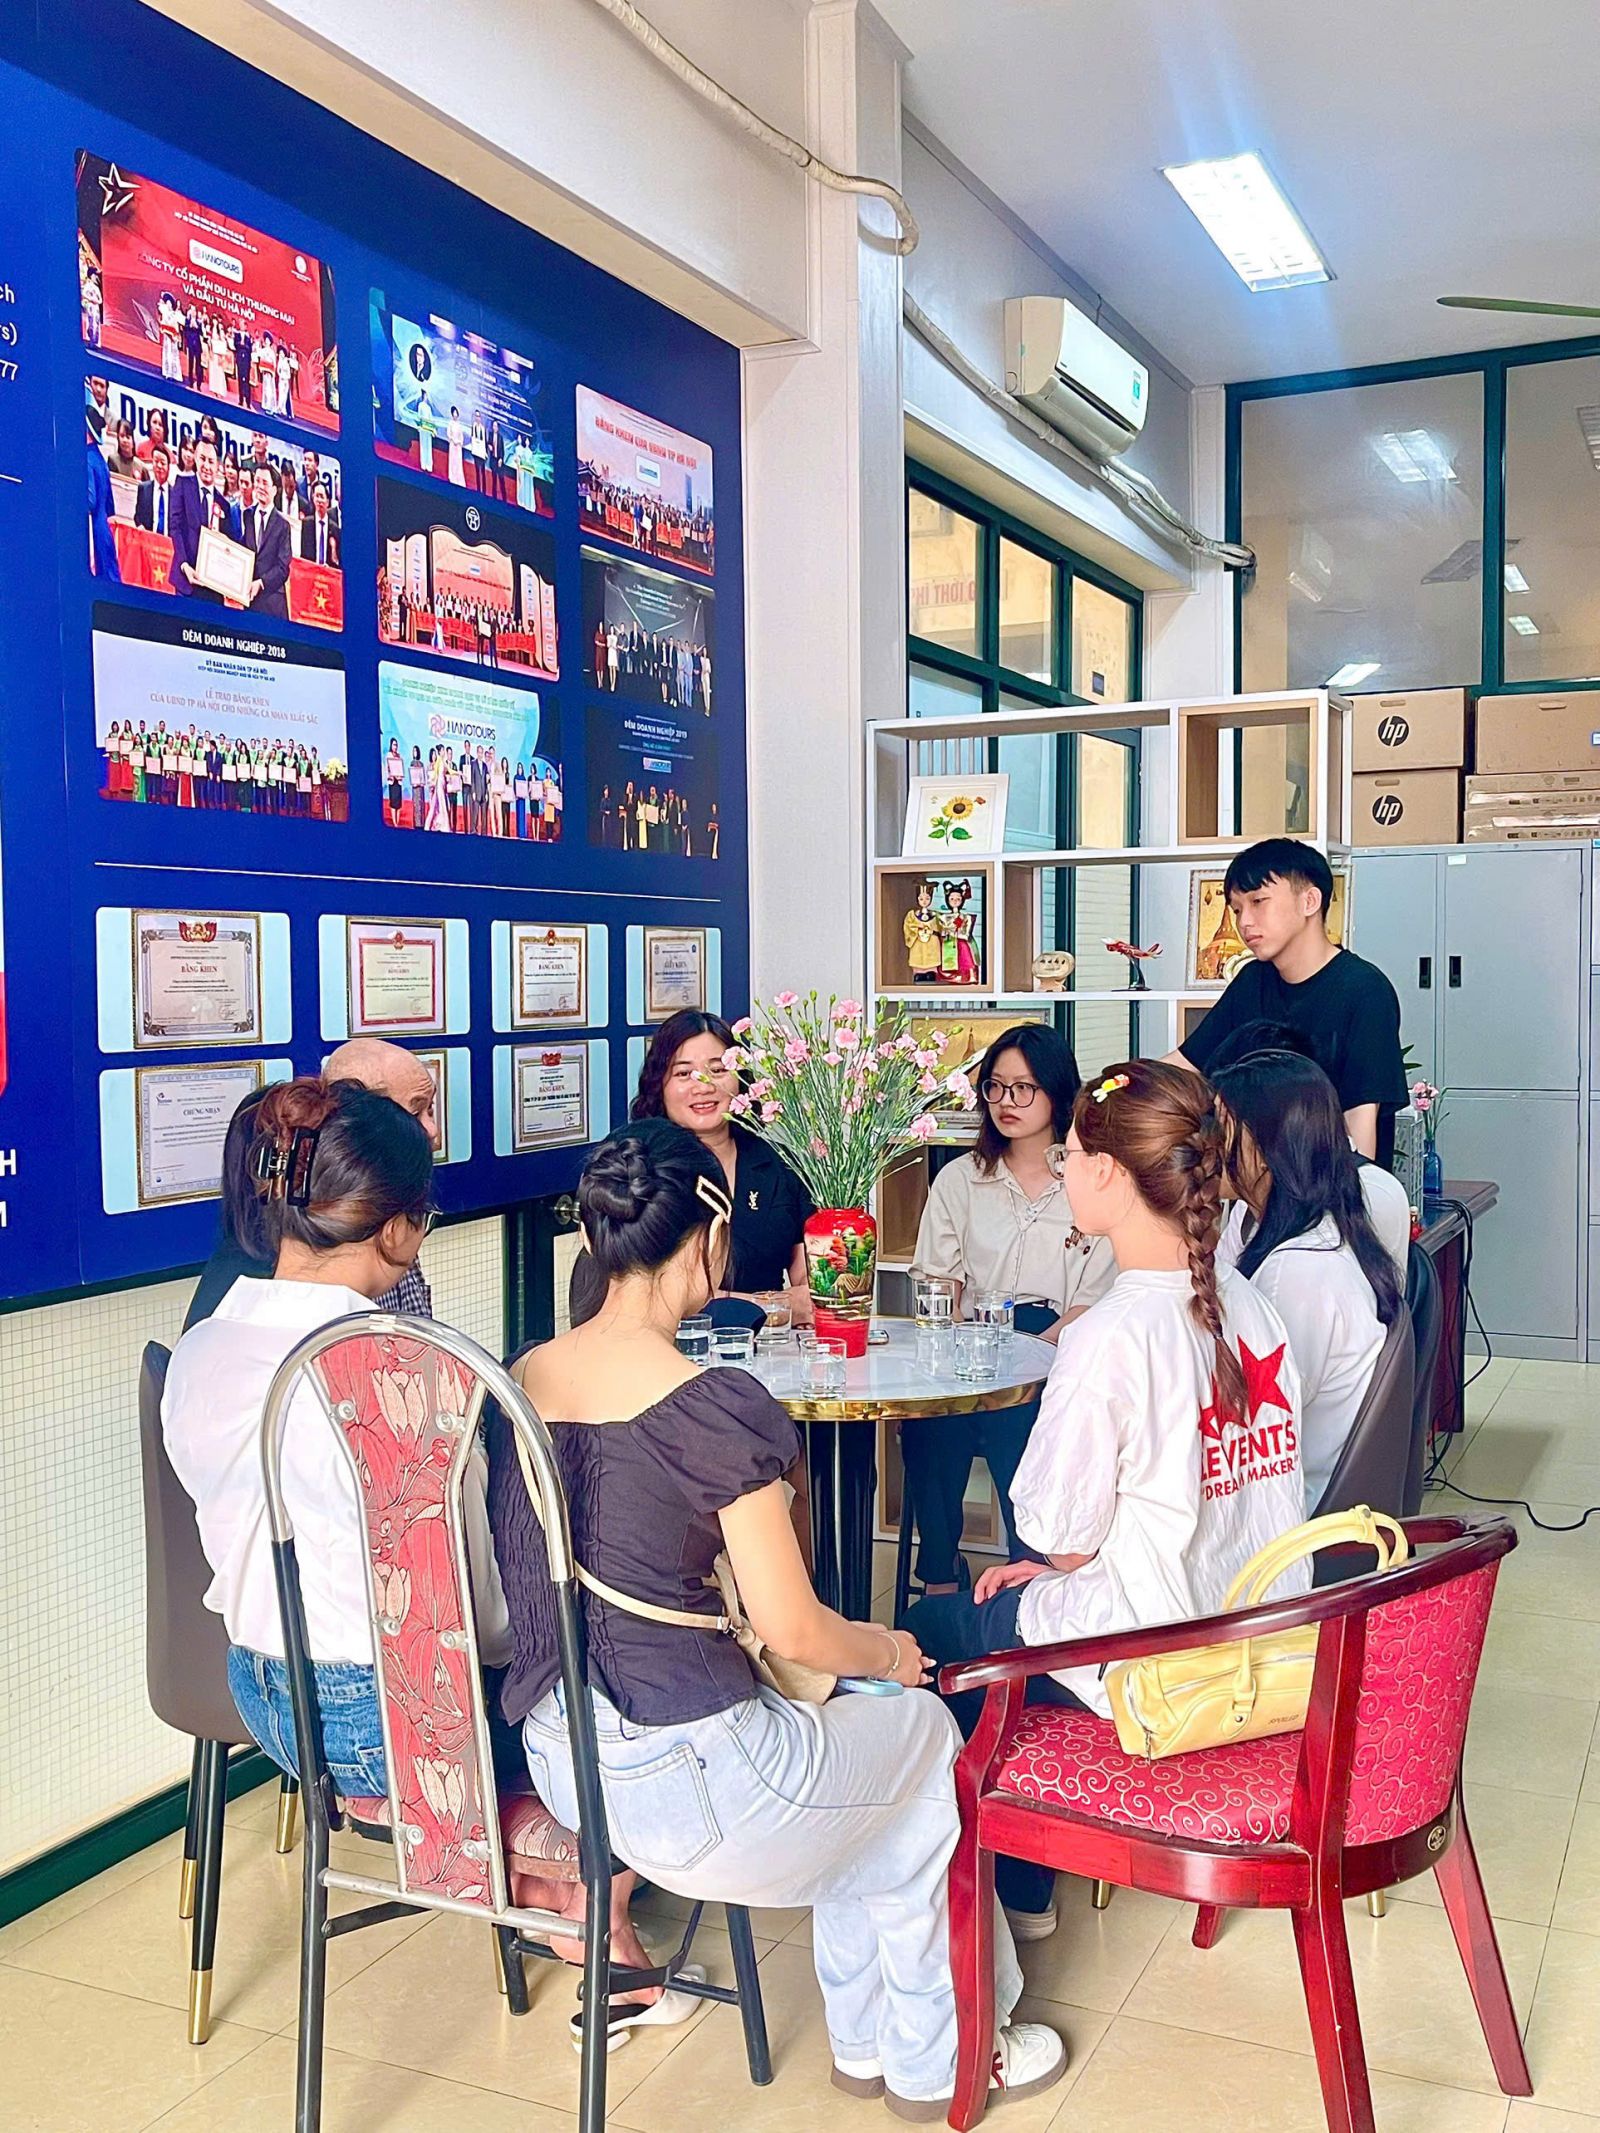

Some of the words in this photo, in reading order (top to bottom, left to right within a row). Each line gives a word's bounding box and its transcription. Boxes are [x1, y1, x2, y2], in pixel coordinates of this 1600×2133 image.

[182, 629, 202, 644] ĐÊM
[204, 633, 234, 649] DOANH
[236, 639, 266, 655] NGHIỆP
[268, 645, 286, 659] 2018
[1381, 716, 1407, 747] hp
[1376, 795, 1402, 826] hp
